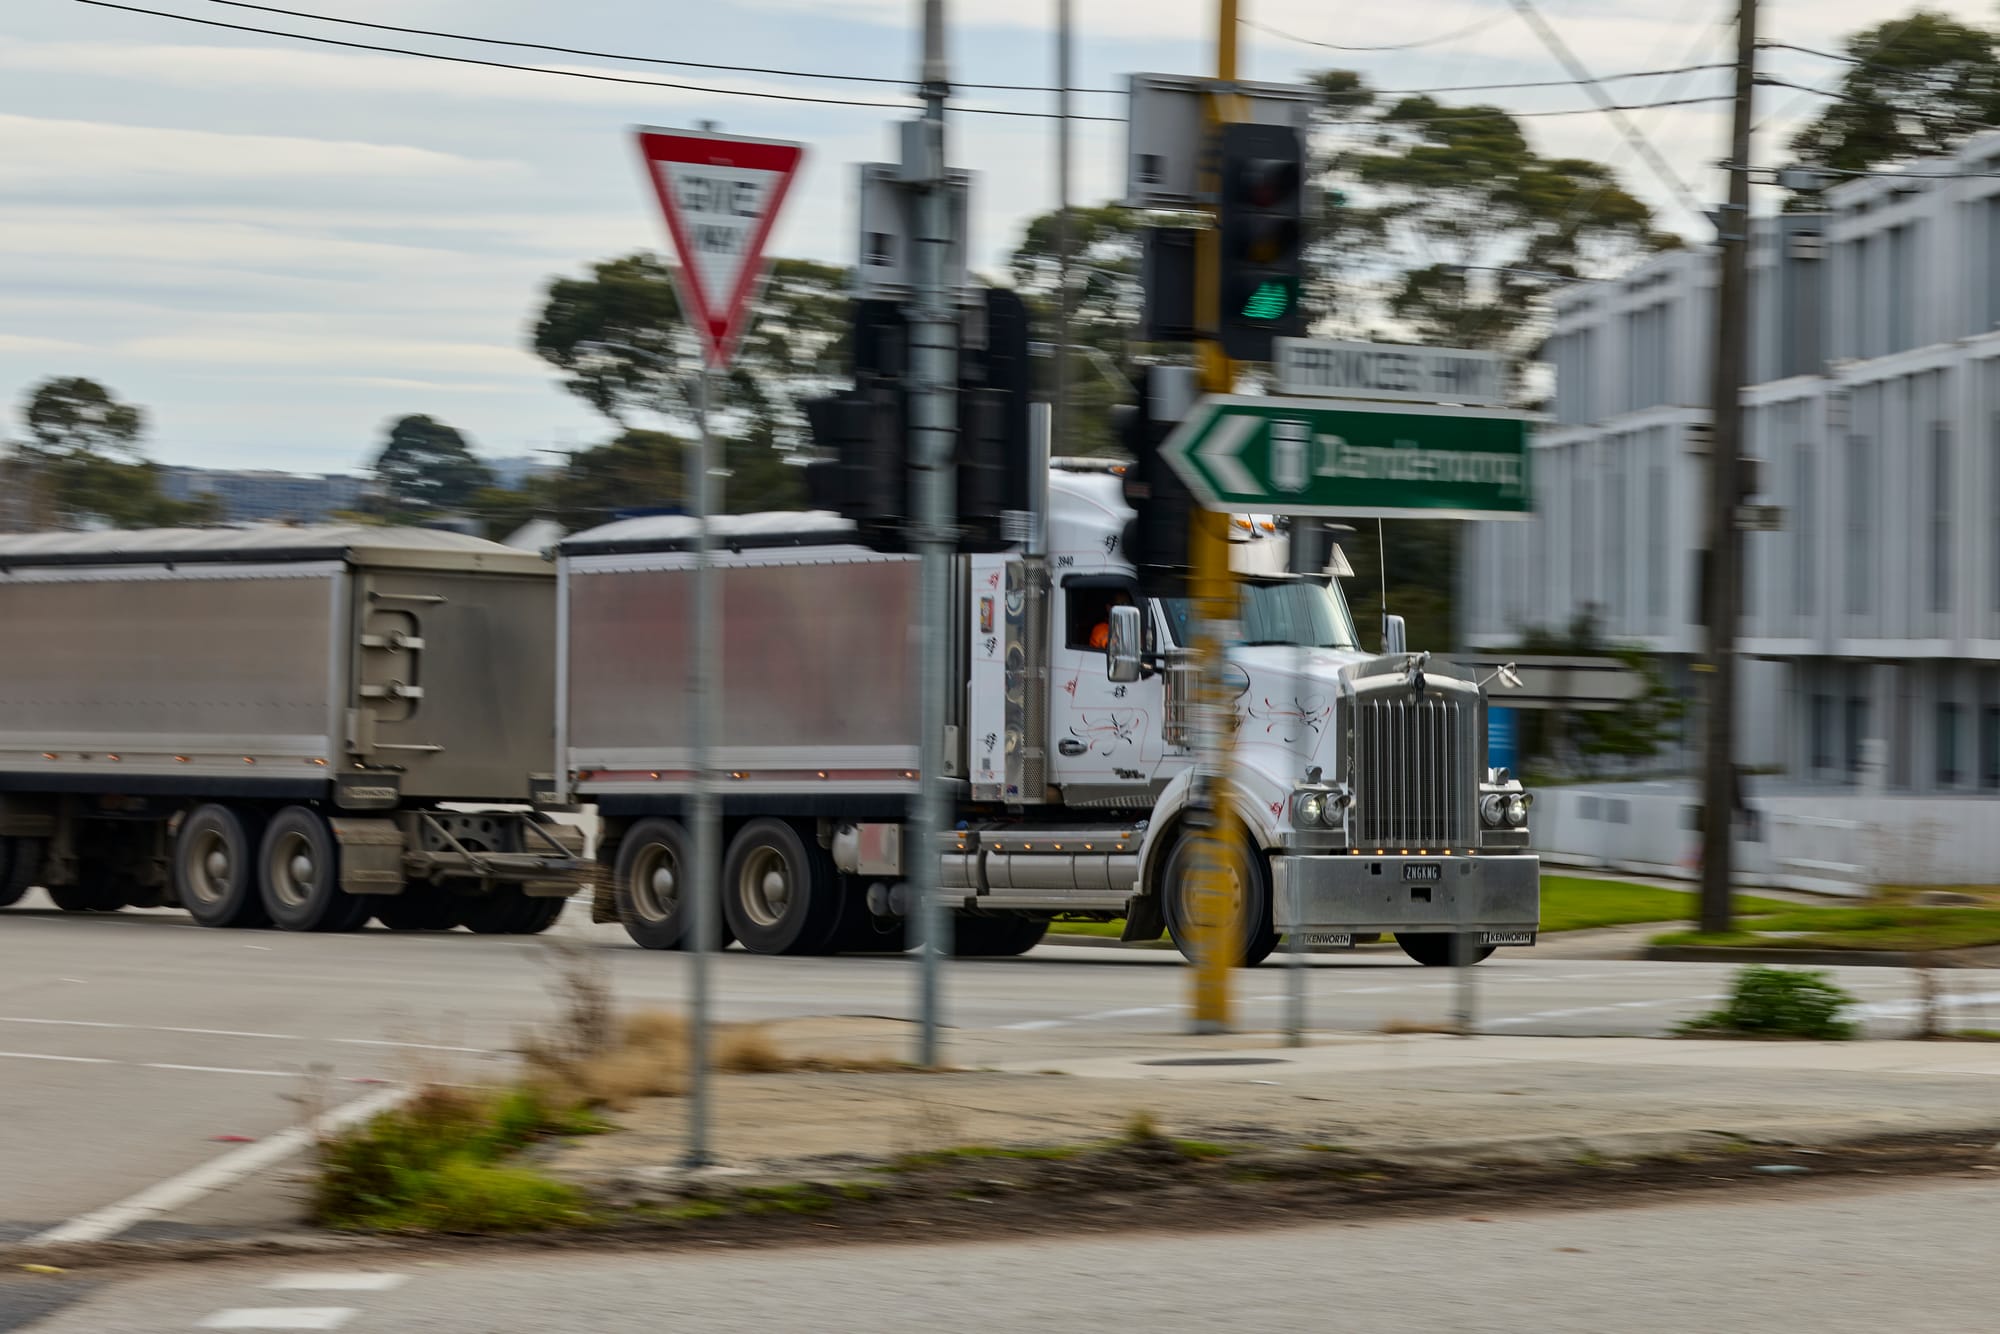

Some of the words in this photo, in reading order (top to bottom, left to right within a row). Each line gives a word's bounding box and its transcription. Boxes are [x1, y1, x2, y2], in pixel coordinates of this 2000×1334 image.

[1312, 432, 1521, 497] Dandenong
[1305, 934, 1350, 945] KENWORTH
[1490, 933, 1531, 943] KENWORTH
